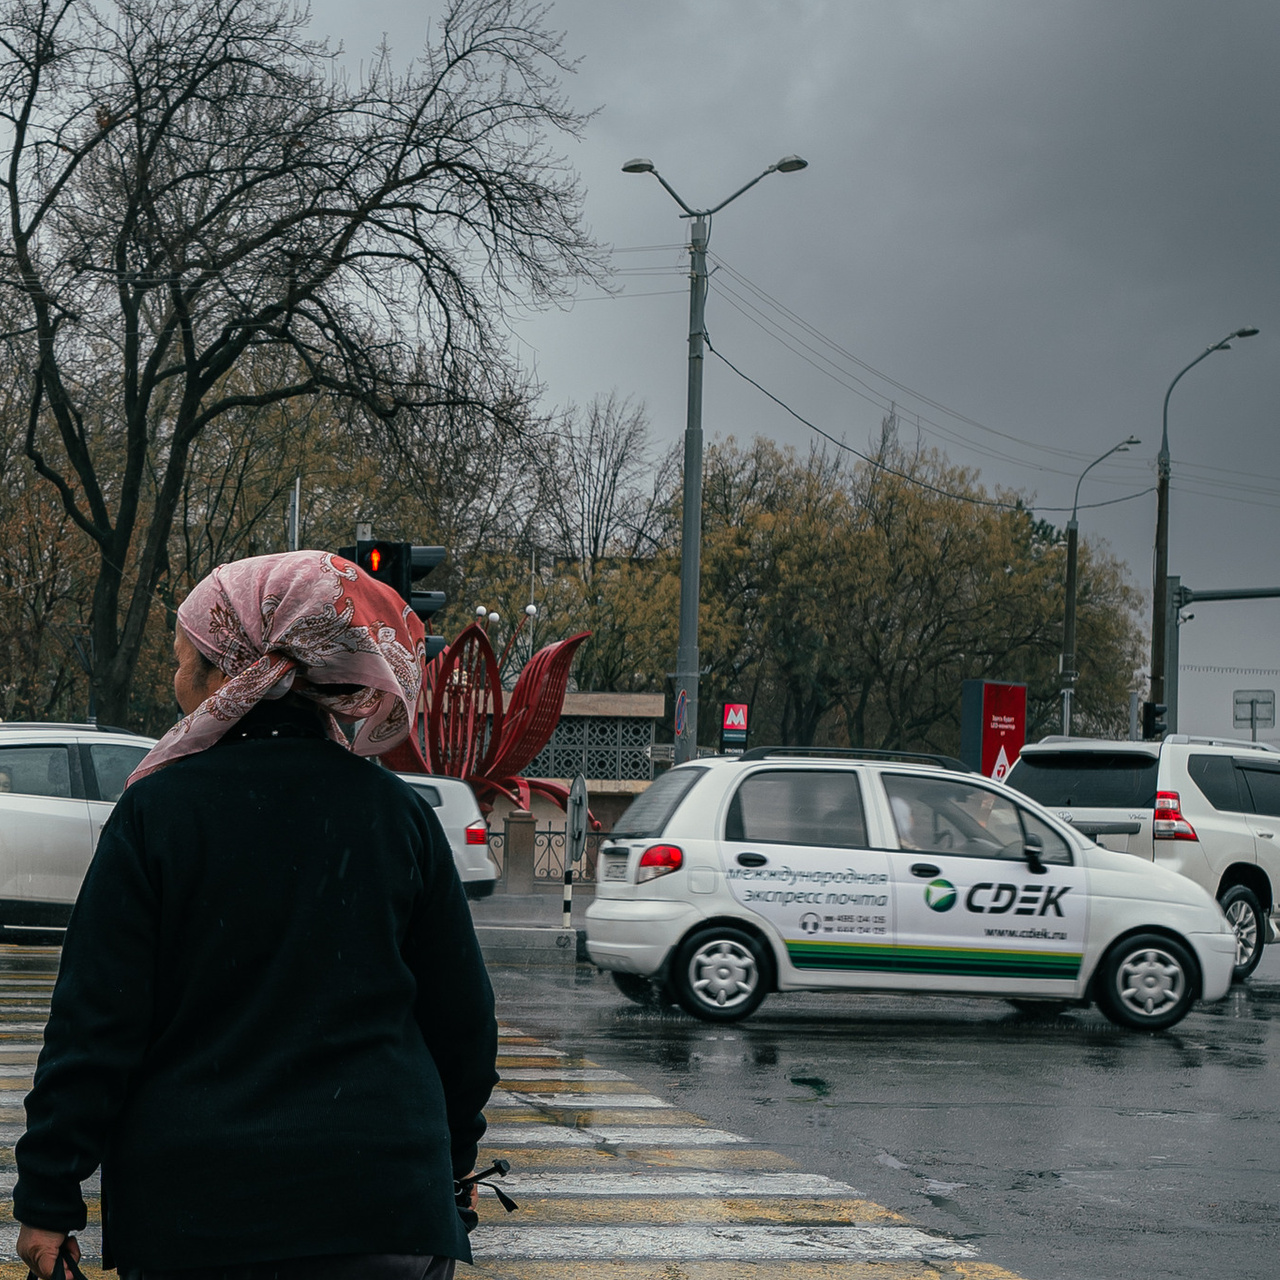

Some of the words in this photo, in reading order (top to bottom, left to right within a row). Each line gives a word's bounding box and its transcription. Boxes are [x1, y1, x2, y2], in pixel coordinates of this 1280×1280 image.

[726, 707, 745, 726] M
[725, 865, 889, 887] международная
[742, 889, 823, 907] экспресс
[824, 892, 889, 907] почта
[965, 882, 1073, 918] CDEK
[983, 927, 1068, 940] www.cdek.ru
